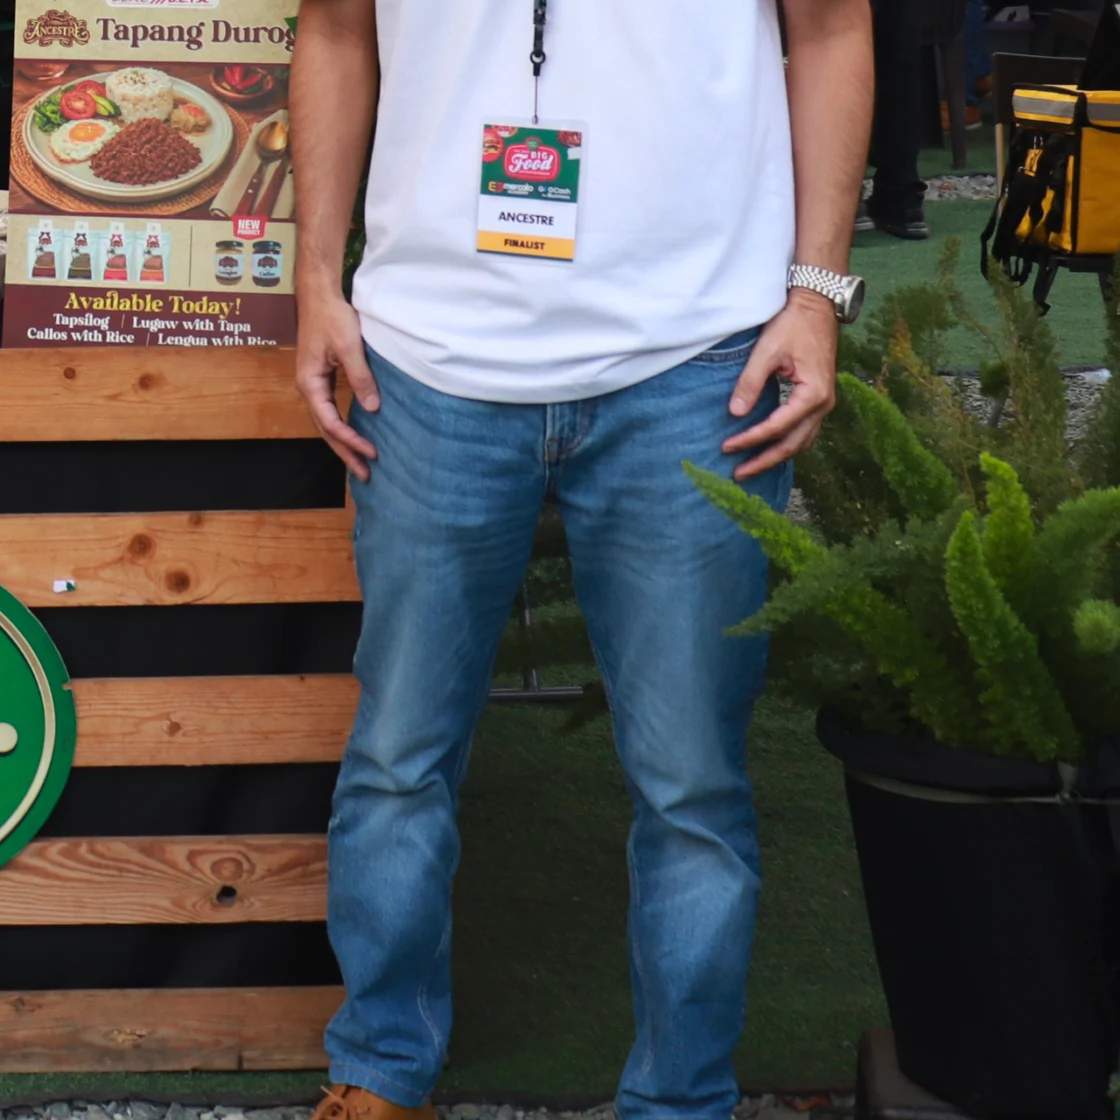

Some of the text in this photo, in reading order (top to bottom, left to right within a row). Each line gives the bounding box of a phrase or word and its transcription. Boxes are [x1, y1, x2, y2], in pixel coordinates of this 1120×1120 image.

[30, 21, 83, 39] ANCESTRE
[96, 17, 206, 51] Tapang
[508, 152, 554, 173] Food
[530, 151, 548, 159] BIG
[237, 219, 260, 229] NEW
[498, 211, 555, 226] ANCESTRE
[504, 238, 545, 250] FINALIST
[64, 290, 241, 319] Available Today!
[53, 312, 251, 334] Tapsilog Lugaw with Tapa
[27, 327, 67, 340] Callos
[71, 329, 102, 342] with
[106, 331, 135, 343] Rice
[158, 333, 208, 346] Lengua
[211, 335, 243, 346] with
